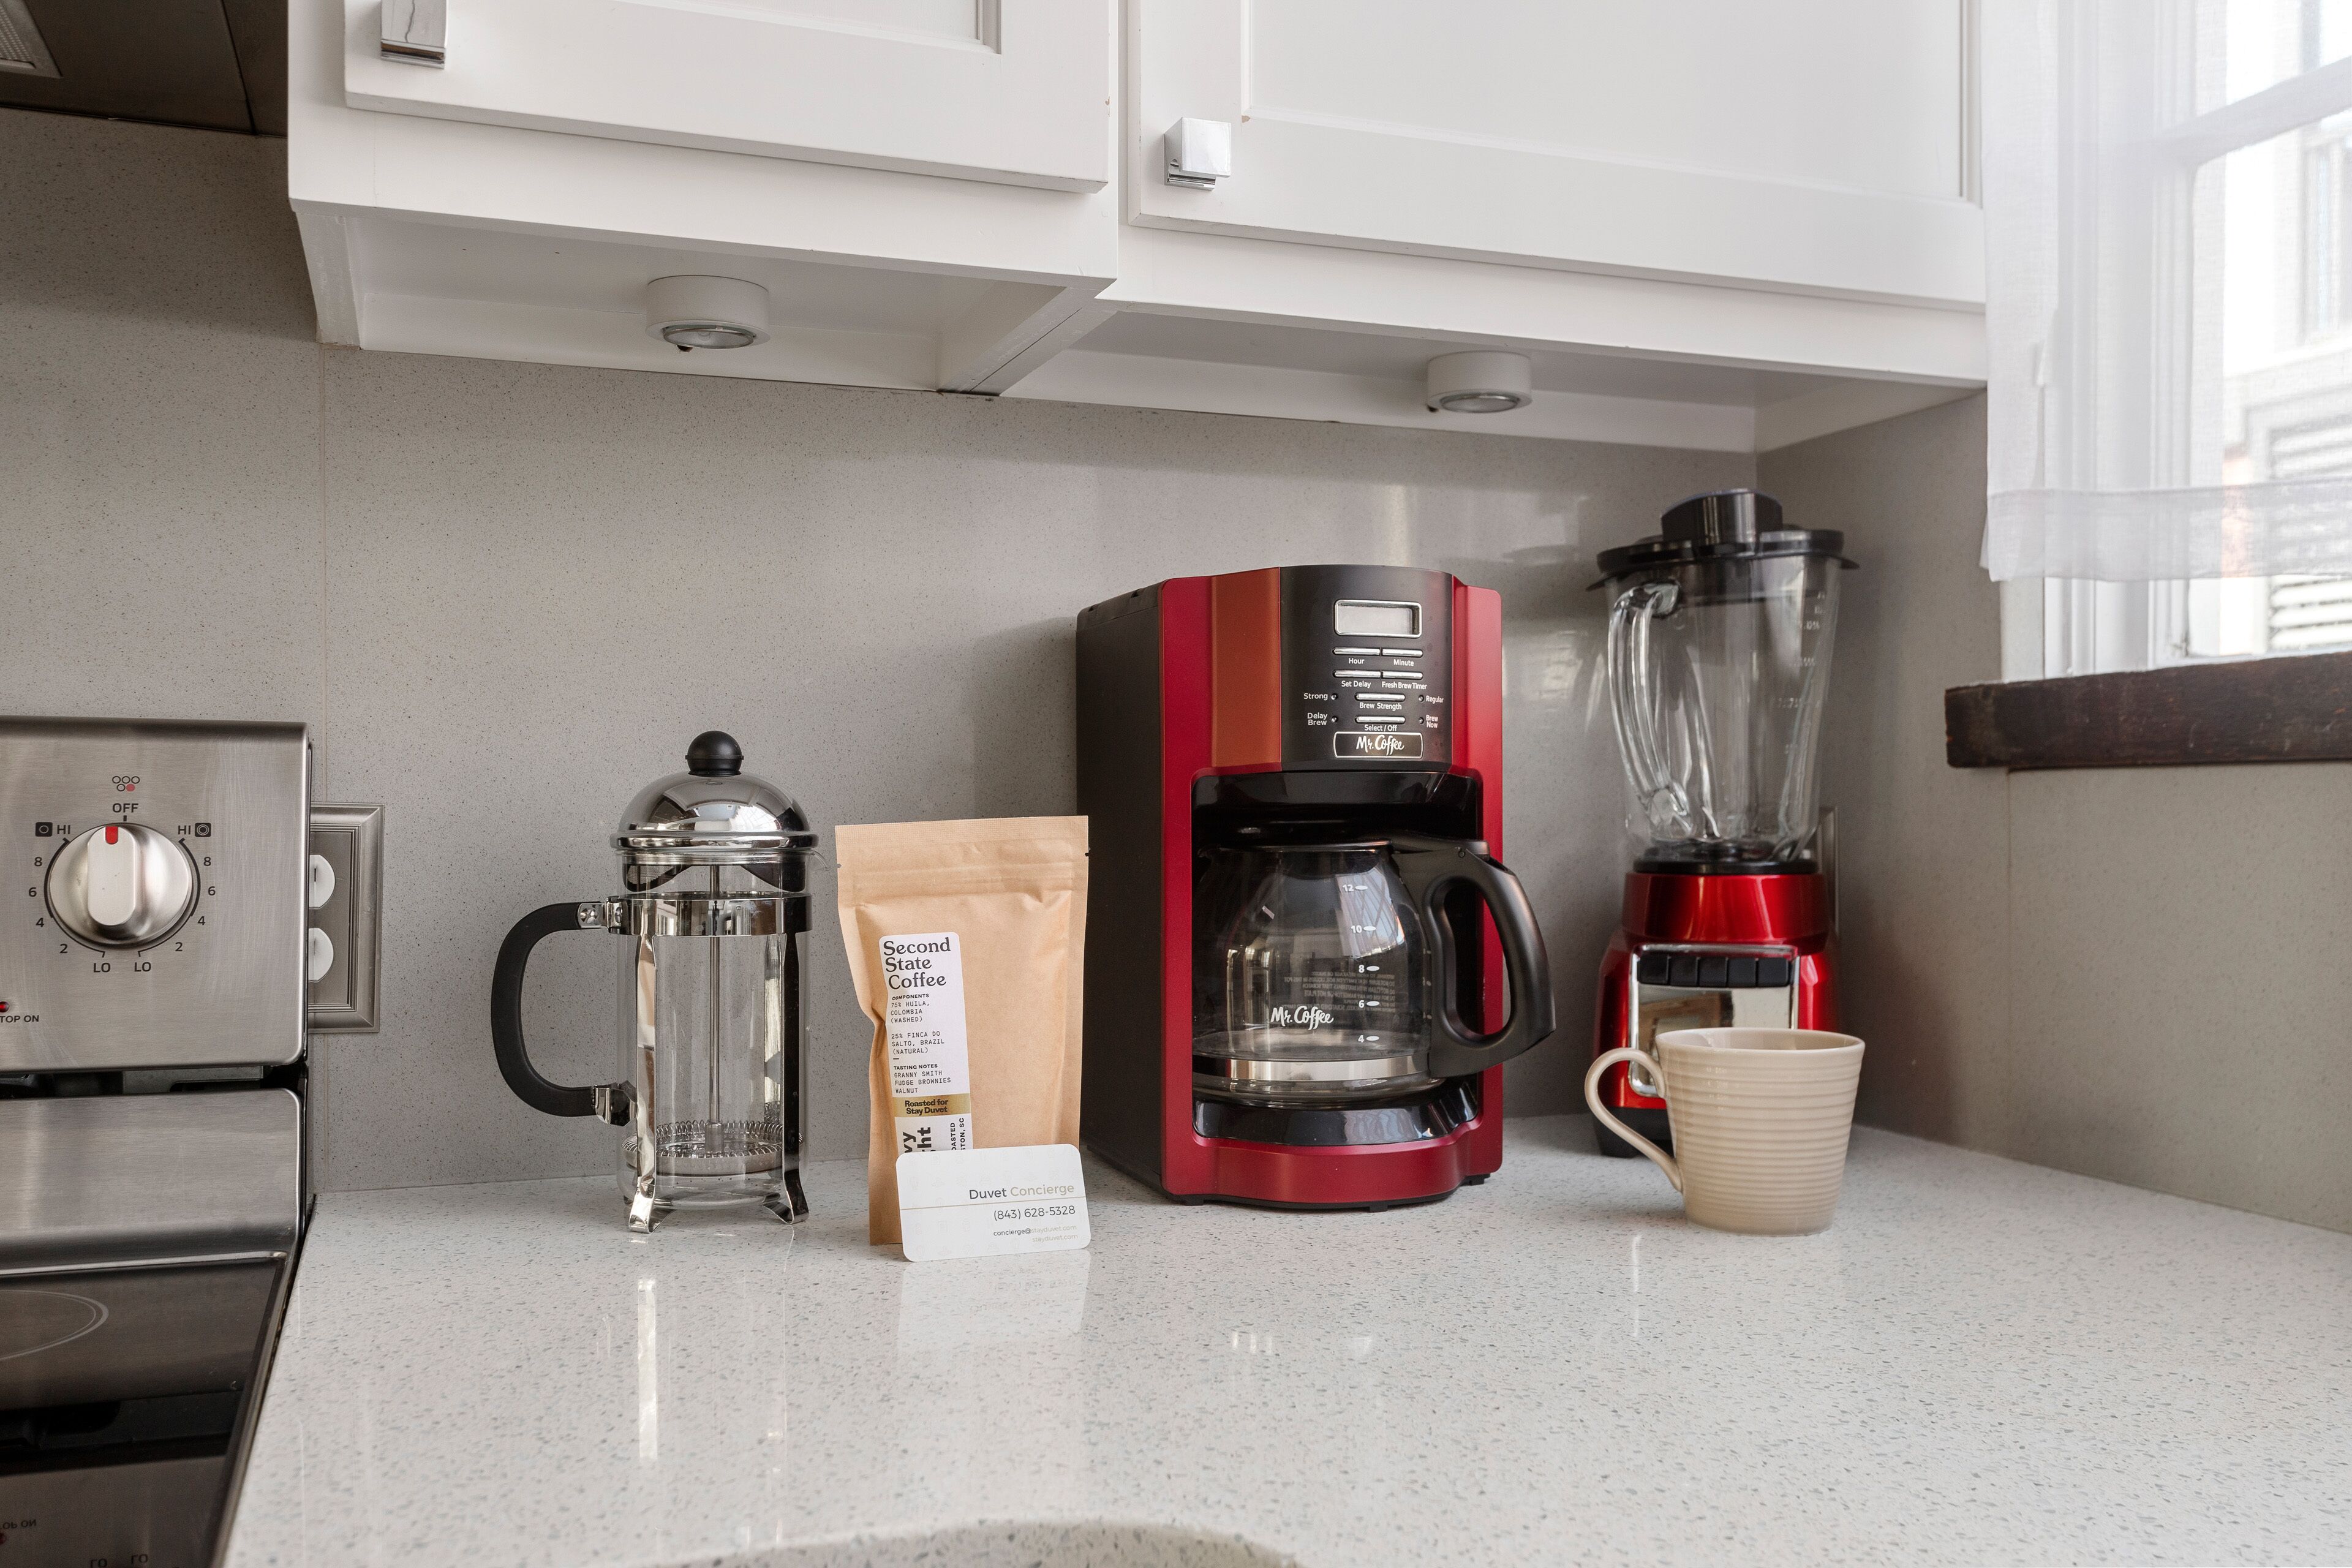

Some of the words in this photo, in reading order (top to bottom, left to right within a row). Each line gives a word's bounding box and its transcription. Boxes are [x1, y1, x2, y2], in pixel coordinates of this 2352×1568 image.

[1356, 736, 1374, 752] Mr.
[1374, 735, 1404, 756] Coffee
[112, 803, 138, 813] OFF
[57, 825, 71, 834] HI
[178, 825, 191, 834] HI
[34, 857, 42, 867] 8
[203, 857, 211, 866] 8
[29, 887, 37, 897] 6
[208, 886, 216, 896] 6
[36, 918, 44, 927] 4
[198, 916, 206, 925] 4
[60, 944, 68, 954] 2
[175, 942, 183, 952] 2
[883, 937, 951, 956] Second
[93, 962, 111, 973] LO
[134, 962, 151, 972] LO
[886, 956, 932, 972] State
[1359, 965, 1365, 973] 8
[888, 972, 946, 990] Coffee
[1359, 1000, 1365, 1008] 6
[1271, 1006, 1292, 1027] Mr.
[1294, 1005, 1334, 1030] Coffee
[1358, 1035, 1364, 1043] 4
[906, 1107, 923, 1116] Stay
[959, 1117, 965, 1127] SC
[969, 1188, 1007, 1199] Duvet
[1010, 1184, 1074, 1196] Concierge
[993, 1208, 1021, 1221] (843)
[1024, 1205, 1076, 1218] 628-5328
[993, 1224, 1077, 1237] concierge@stayduvet.com
[1032, 1234, 1078, 1243] stayduvet.com
